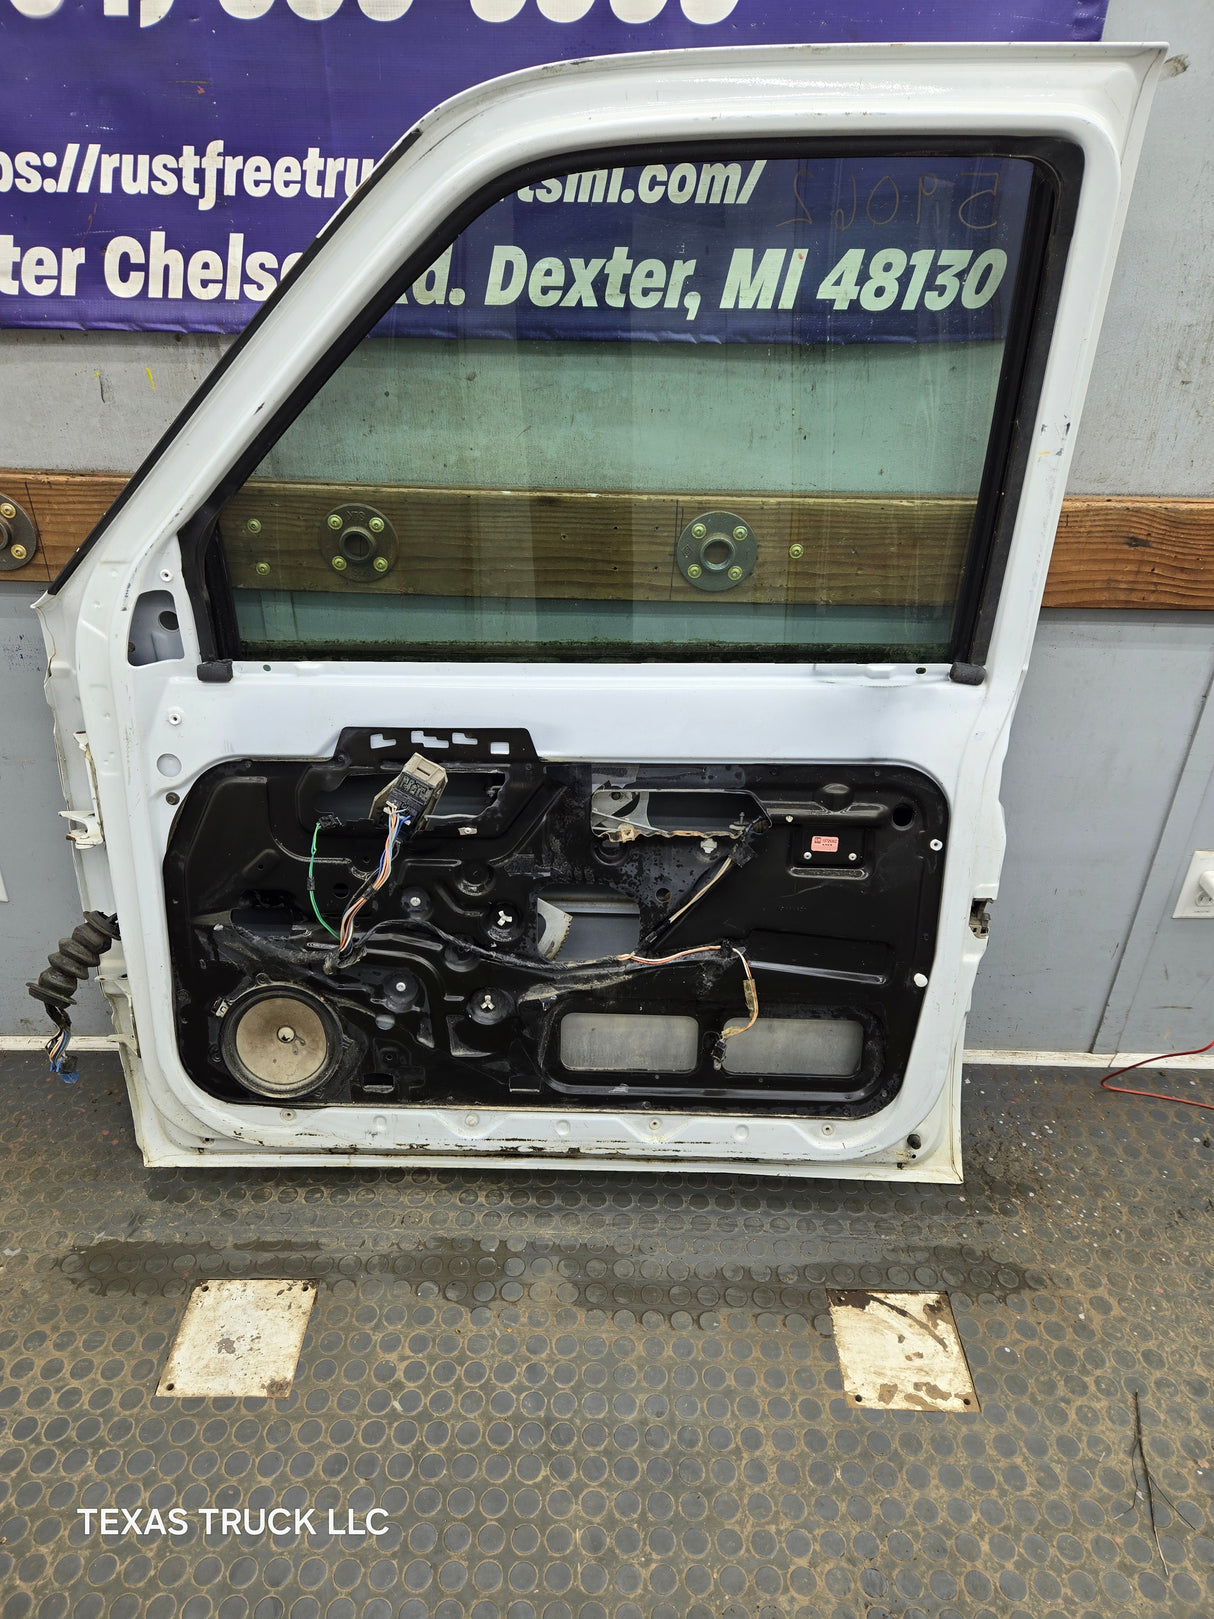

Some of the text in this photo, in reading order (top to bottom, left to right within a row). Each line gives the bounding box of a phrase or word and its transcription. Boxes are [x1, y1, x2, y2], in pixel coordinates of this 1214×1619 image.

[396, 240, 466, 306] d.
[484, 245, 701, 320] Dexter,
[719, 248, 808, 309] MI
[816, 248, 1007, 311] 48130
